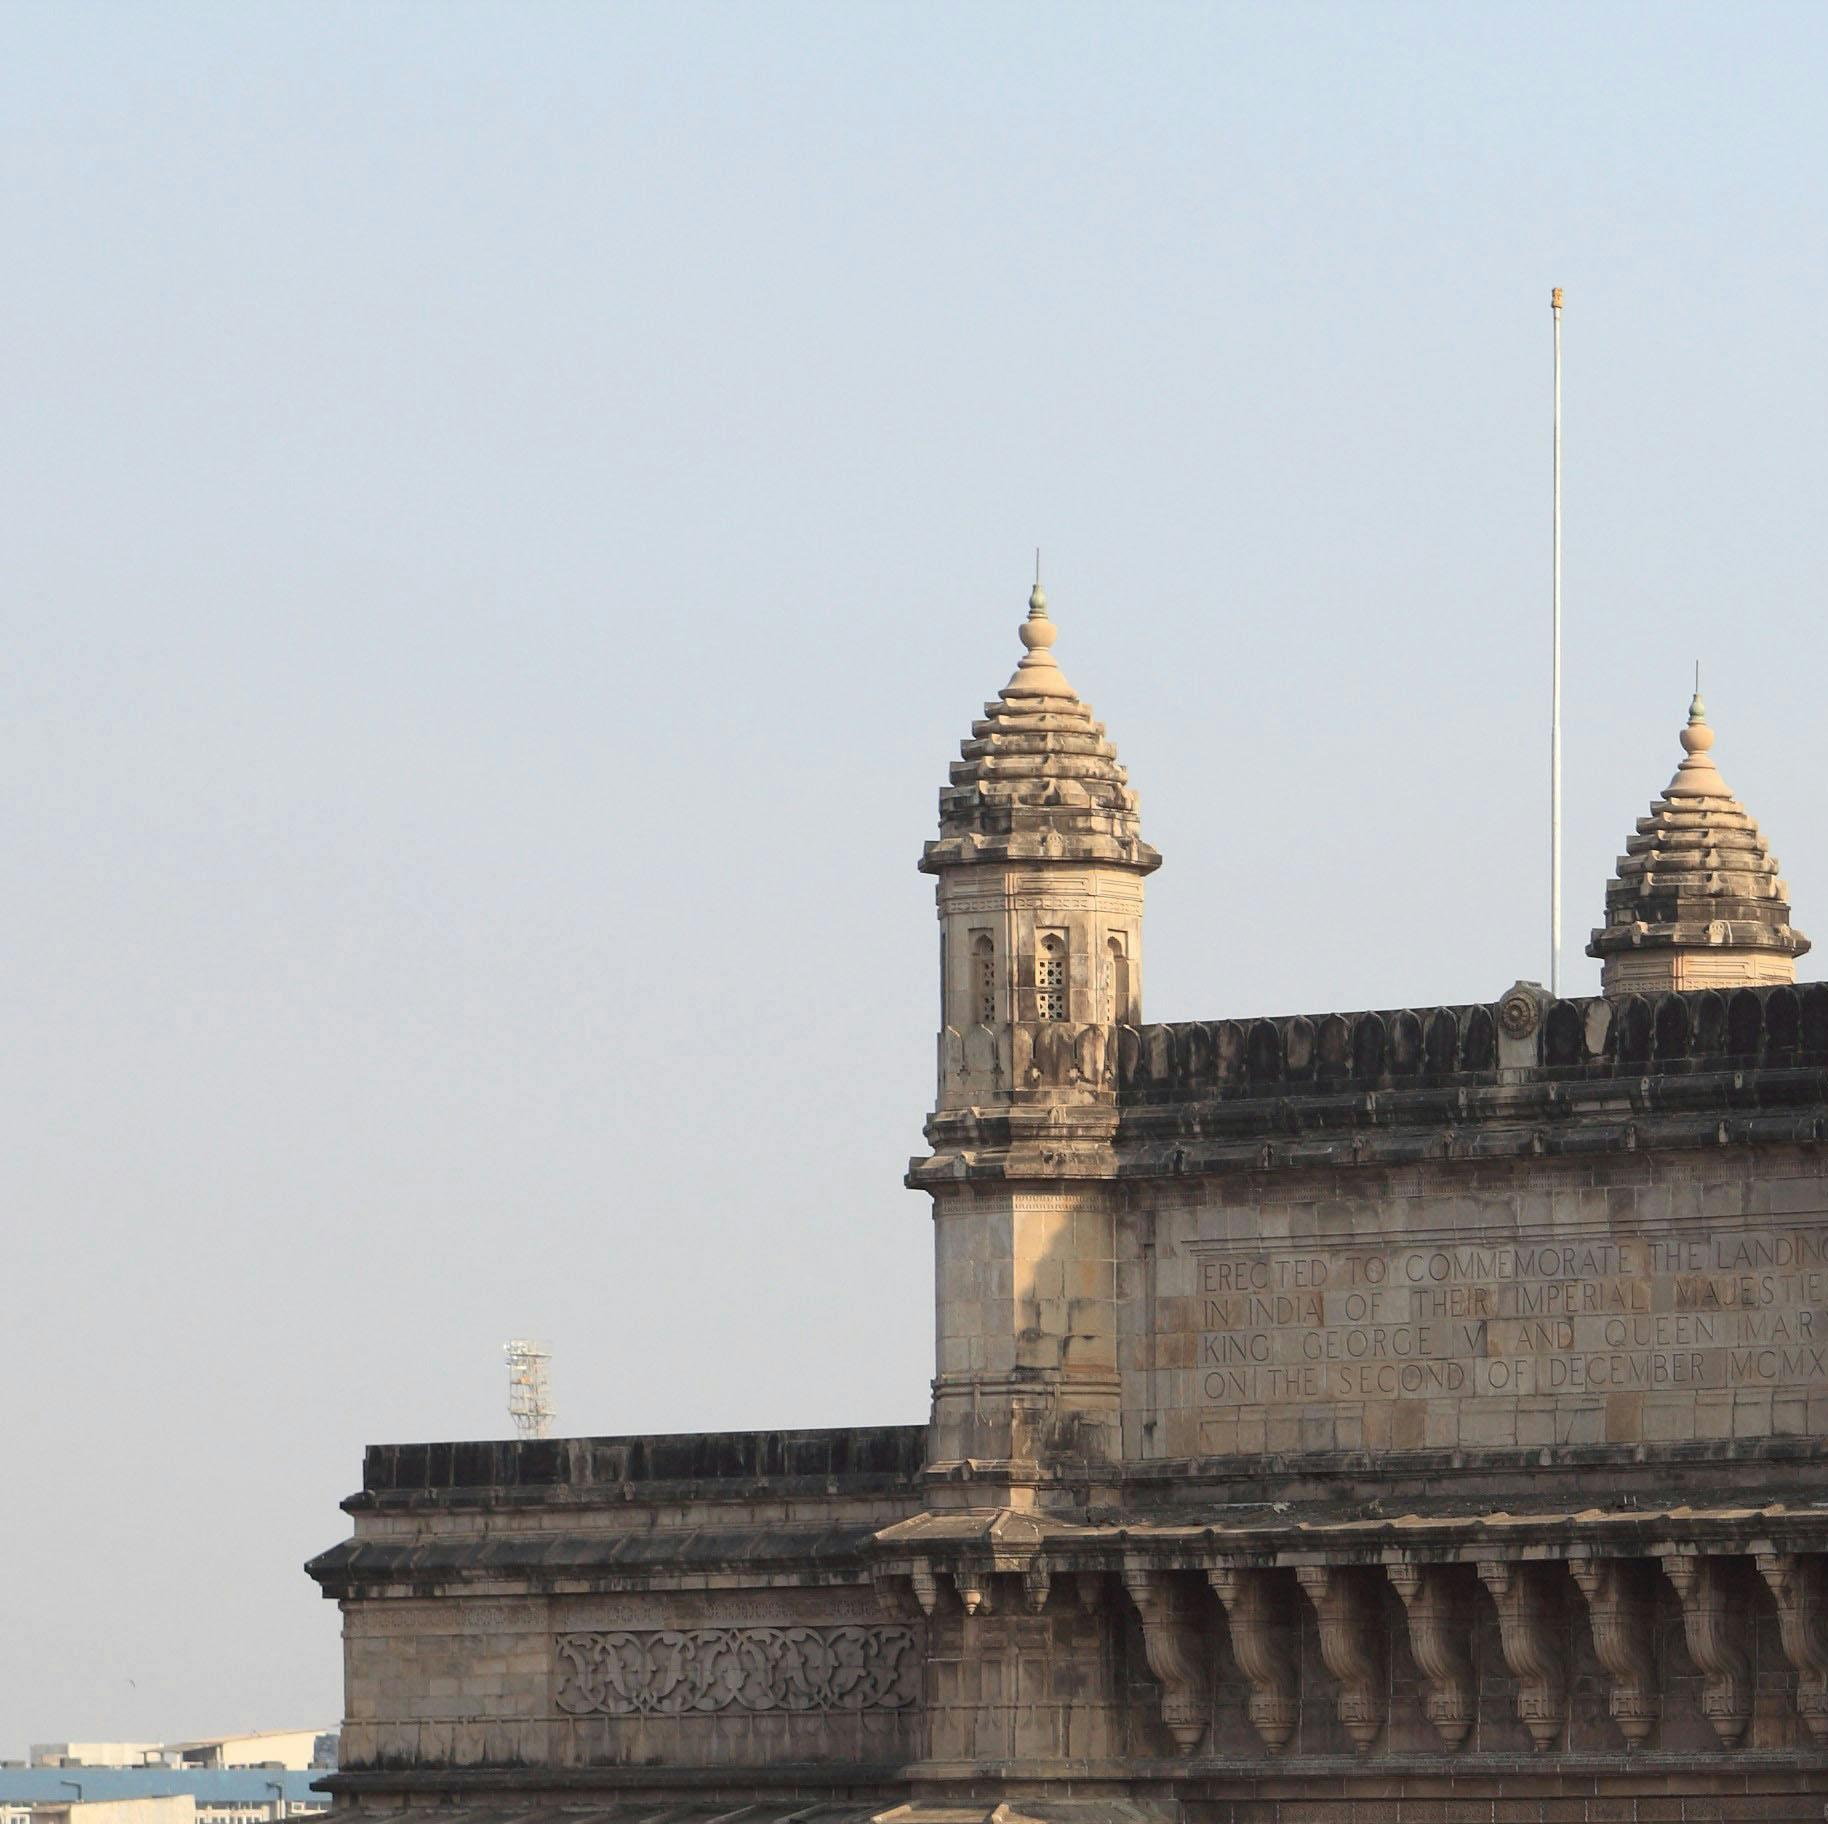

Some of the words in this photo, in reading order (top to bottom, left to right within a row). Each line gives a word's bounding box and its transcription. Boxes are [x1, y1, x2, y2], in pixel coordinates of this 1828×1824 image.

[1203, 1259, 1328, 1292] ERECTED
[1346, 1255, 1387, 1284] TO
[1404, 1244, 1633, 1282] COMMEMORATE
[1648, 1241, 1704, 1272] THE
[1203, 1299, 1228, 1328] IN
[1250, 1295, 1323, 1326] INDIA
[1345, 1292, 1384, 1321] OF
[1413, 1288, 1488, 1318] THEIR
[1515, 1282, 1645, 1314] IMPERIAL
[1203, 1334, 1270, 1363] KING
[1302, 1326, 1432, 1360] GEORGE
[1463, 1320, 1487, 1351] V
[1516, 1321, 1575, 1351] AND
[1604, 1315, 1715, 1347] QUEEN
[1203, 1371, 1247, 1399] ON
[1267, 1367, 1319, 1396] THE
[1339, 1363, 1465, 1395] SECOND
[1487, 1359, 1528, 1388] OF
[1550, 1352, 1705, 1387] DECEMBER
